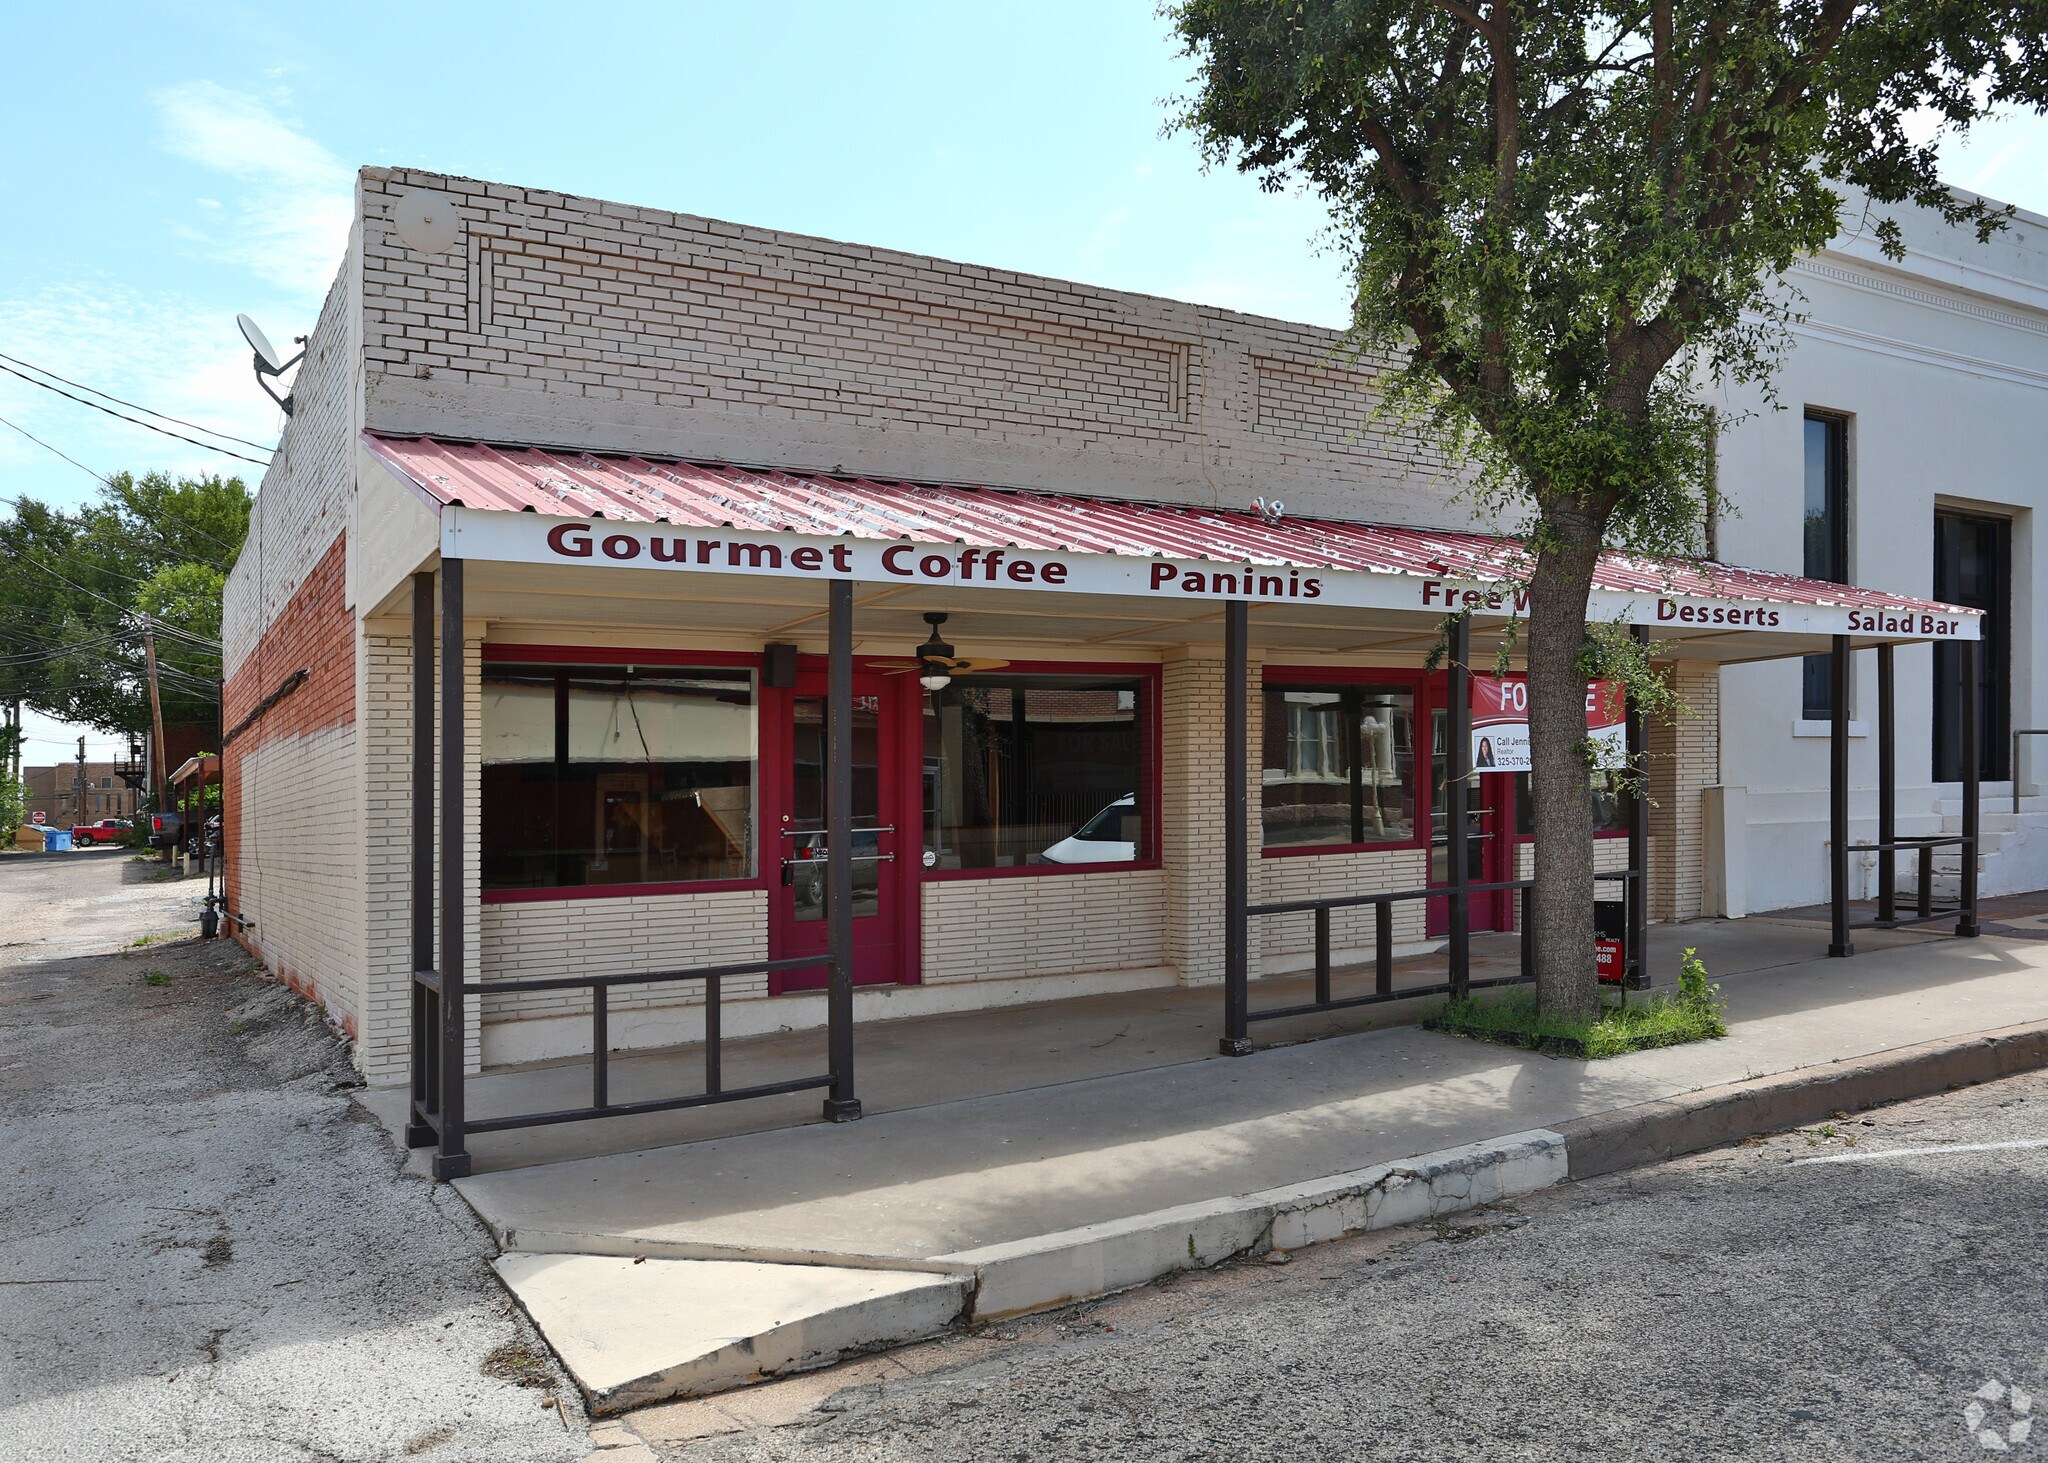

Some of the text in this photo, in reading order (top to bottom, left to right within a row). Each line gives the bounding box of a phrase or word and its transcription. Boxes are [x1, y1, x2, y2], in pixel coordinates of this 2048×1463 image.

[546, 523, 1069, 585] Gourmet Coffee
[1150, 563, 1321, 598] Paninis
[1422, 580, 1503, 610] Free
[1657, 598, 1780, 627] Desserts
[1847, 610, 1959, 636] Salad Bar
[1501, 683, 1527, 711] FO
[1496, 737, 1510, 746] Call
[1497, 757, 1532, 766] 325-370-2
